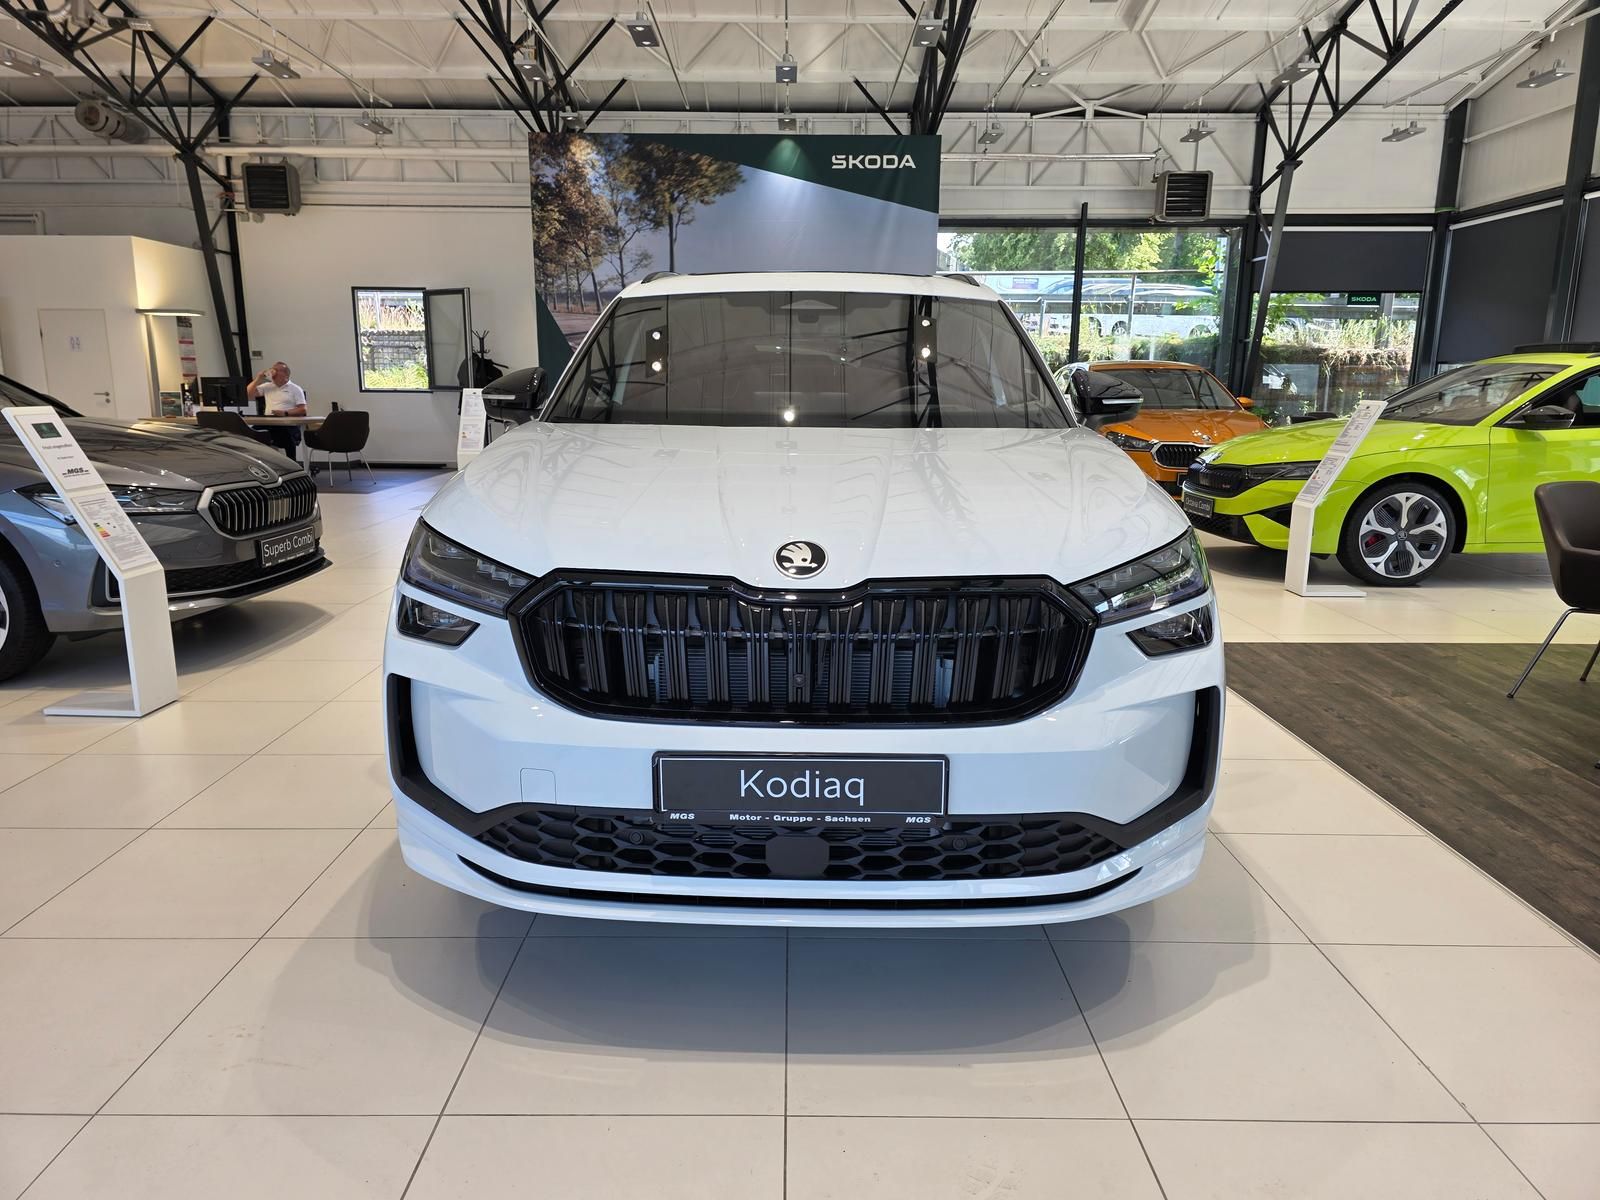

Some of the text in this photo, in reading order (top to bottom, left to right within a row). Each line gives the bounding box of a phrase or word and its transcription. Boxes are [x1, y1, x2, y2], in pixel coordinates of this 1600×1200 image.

[67, 467, 84, 475] MGS
[263, 531, 313, 557] Superb Combi
[740, 769, 864, 806] Kodiaq
[670, 812, 695, 820] MGS
[729, 813, 762, 821] Motor
[773, 814, 813, 822] Gruppe
[824, 815, 871, 823] Sachsen
[905, 816, 931, 824] MGS
